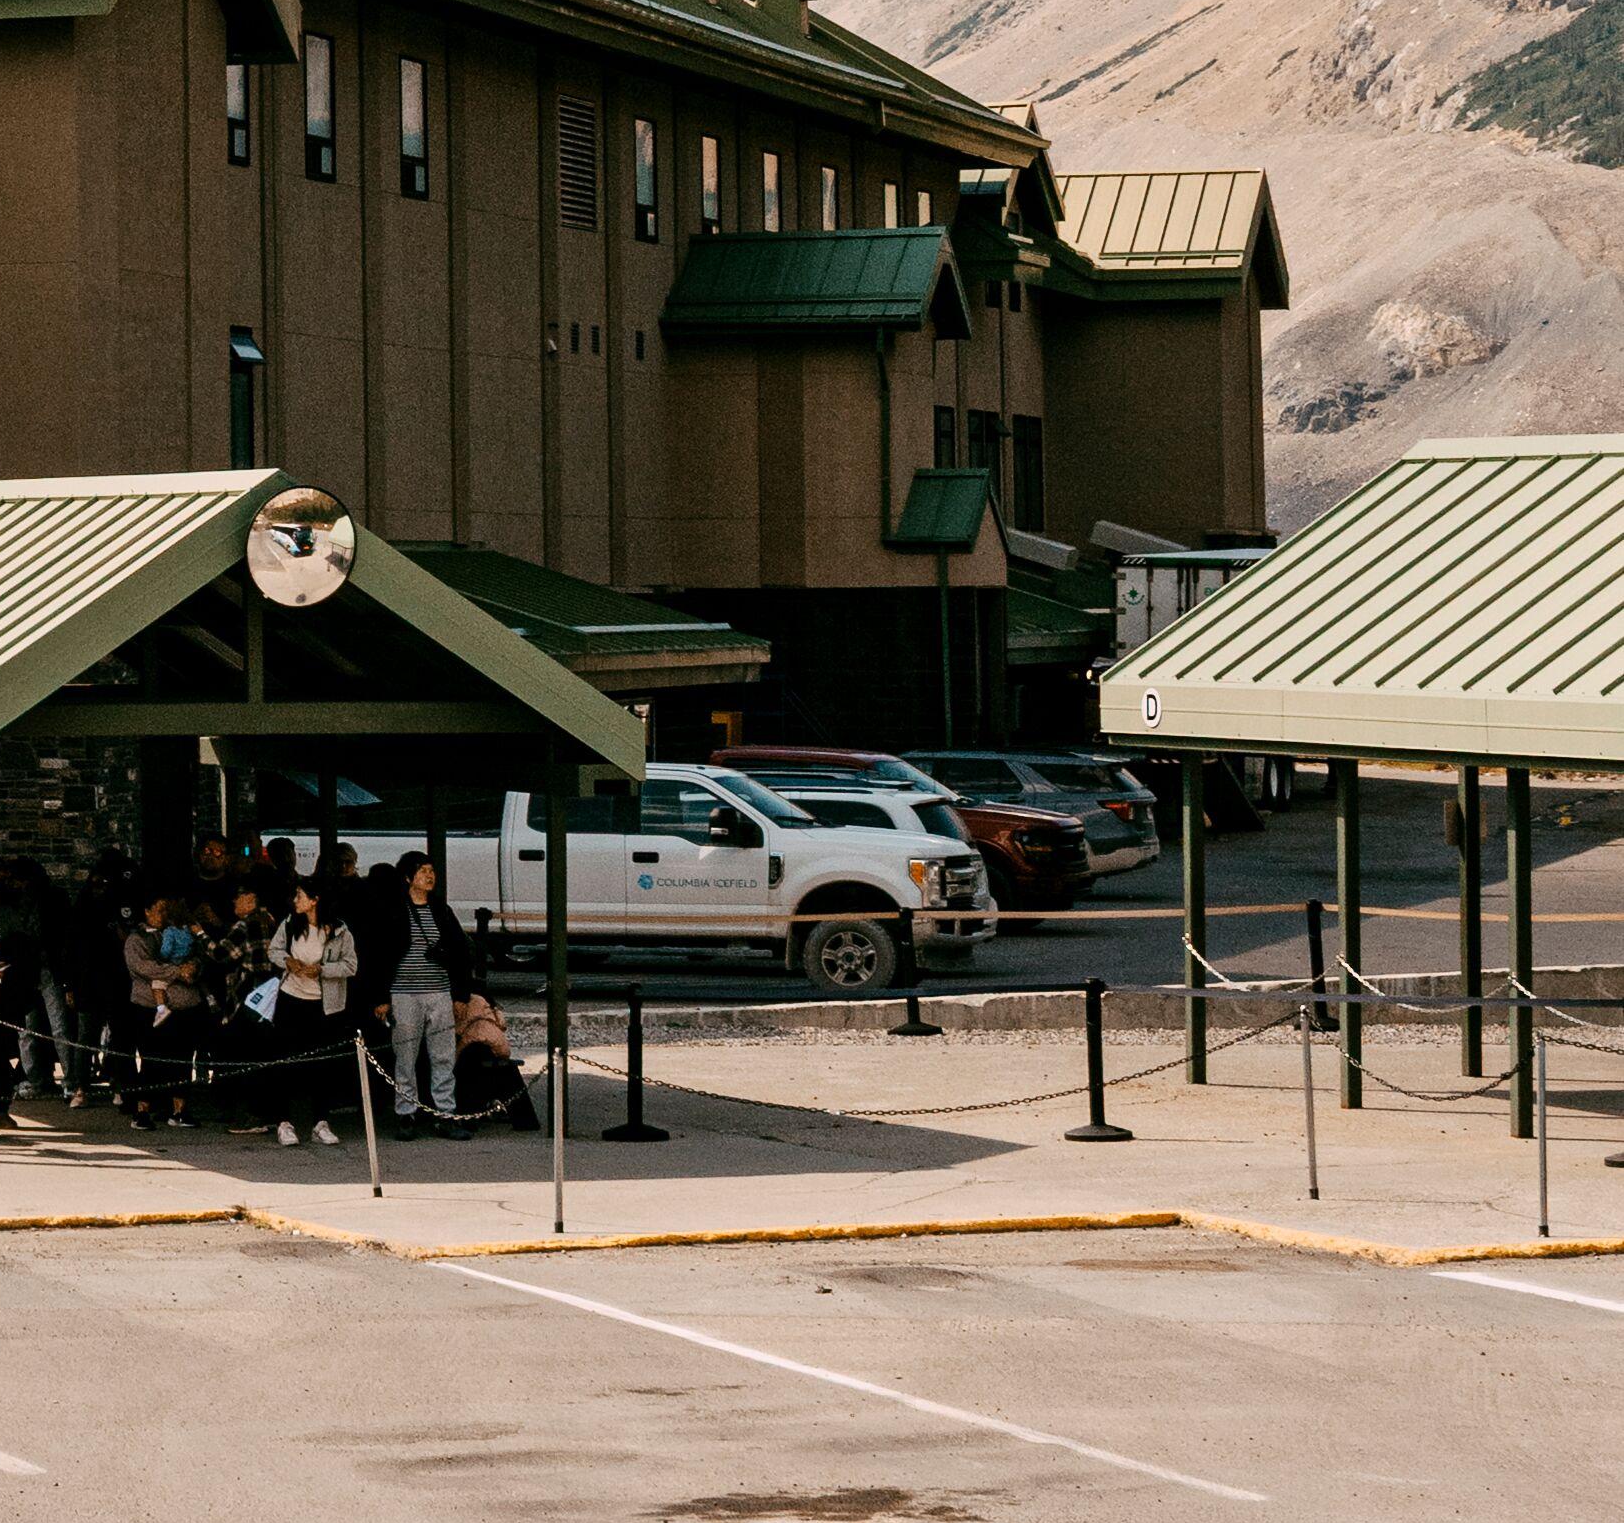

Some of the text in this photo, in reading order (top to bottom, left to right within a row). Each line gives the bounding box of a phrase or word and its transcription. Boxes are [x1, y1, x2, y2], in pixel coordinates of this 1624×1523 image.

[1146, 694, 1158, 721] D
[656, 878, 758, 888] COLUMBIA ICEFIELD
